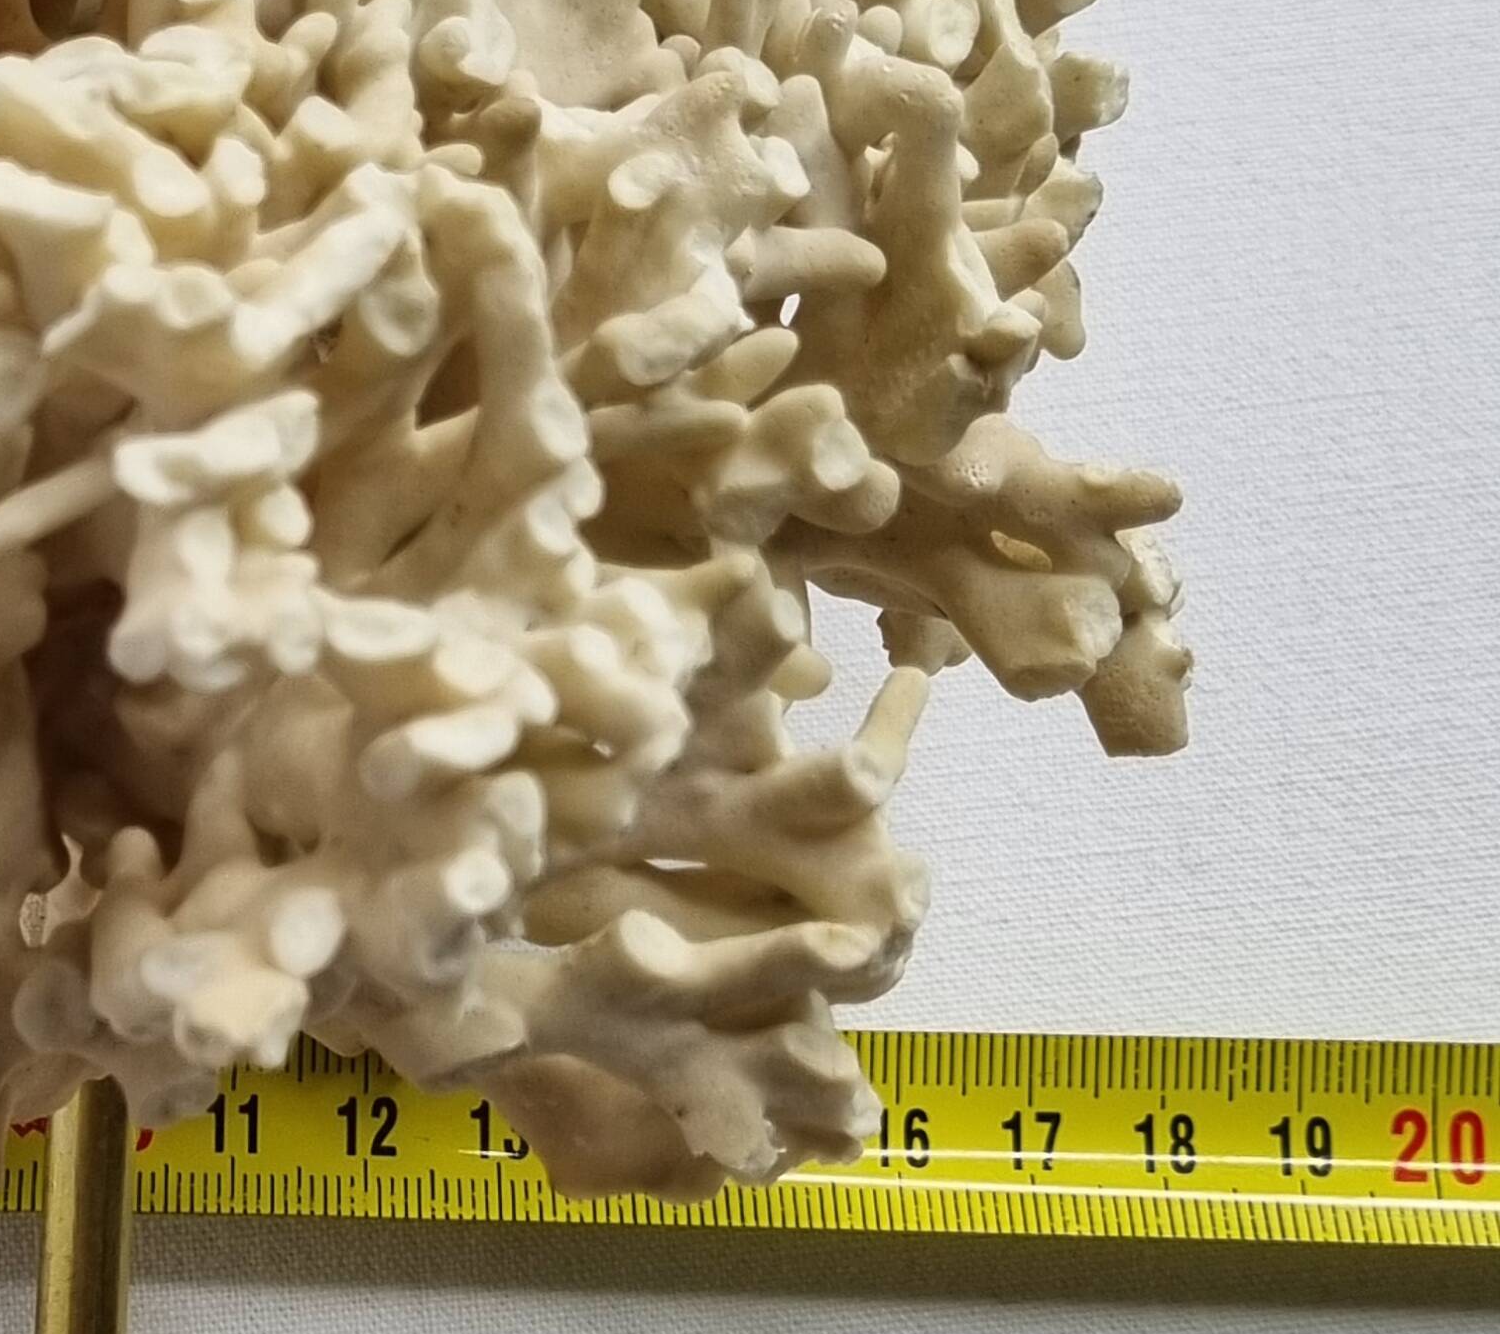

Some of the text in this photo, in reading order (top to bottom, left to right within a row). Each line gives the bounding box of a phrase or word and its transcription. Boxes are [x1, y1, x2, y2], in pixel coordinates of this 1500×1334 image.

[207, 1093, 259, 1154] 11
[337, 1096, 397, 1157] 12
[880, 1108, 930, 1168] 16
[1002, 1111, 1061, 1171] 17
[1134, 1113, 1197, 1174] 18
[1269, 1116, 1333, 1177] 19
[1390, 1108, 1486, 1186] 20
